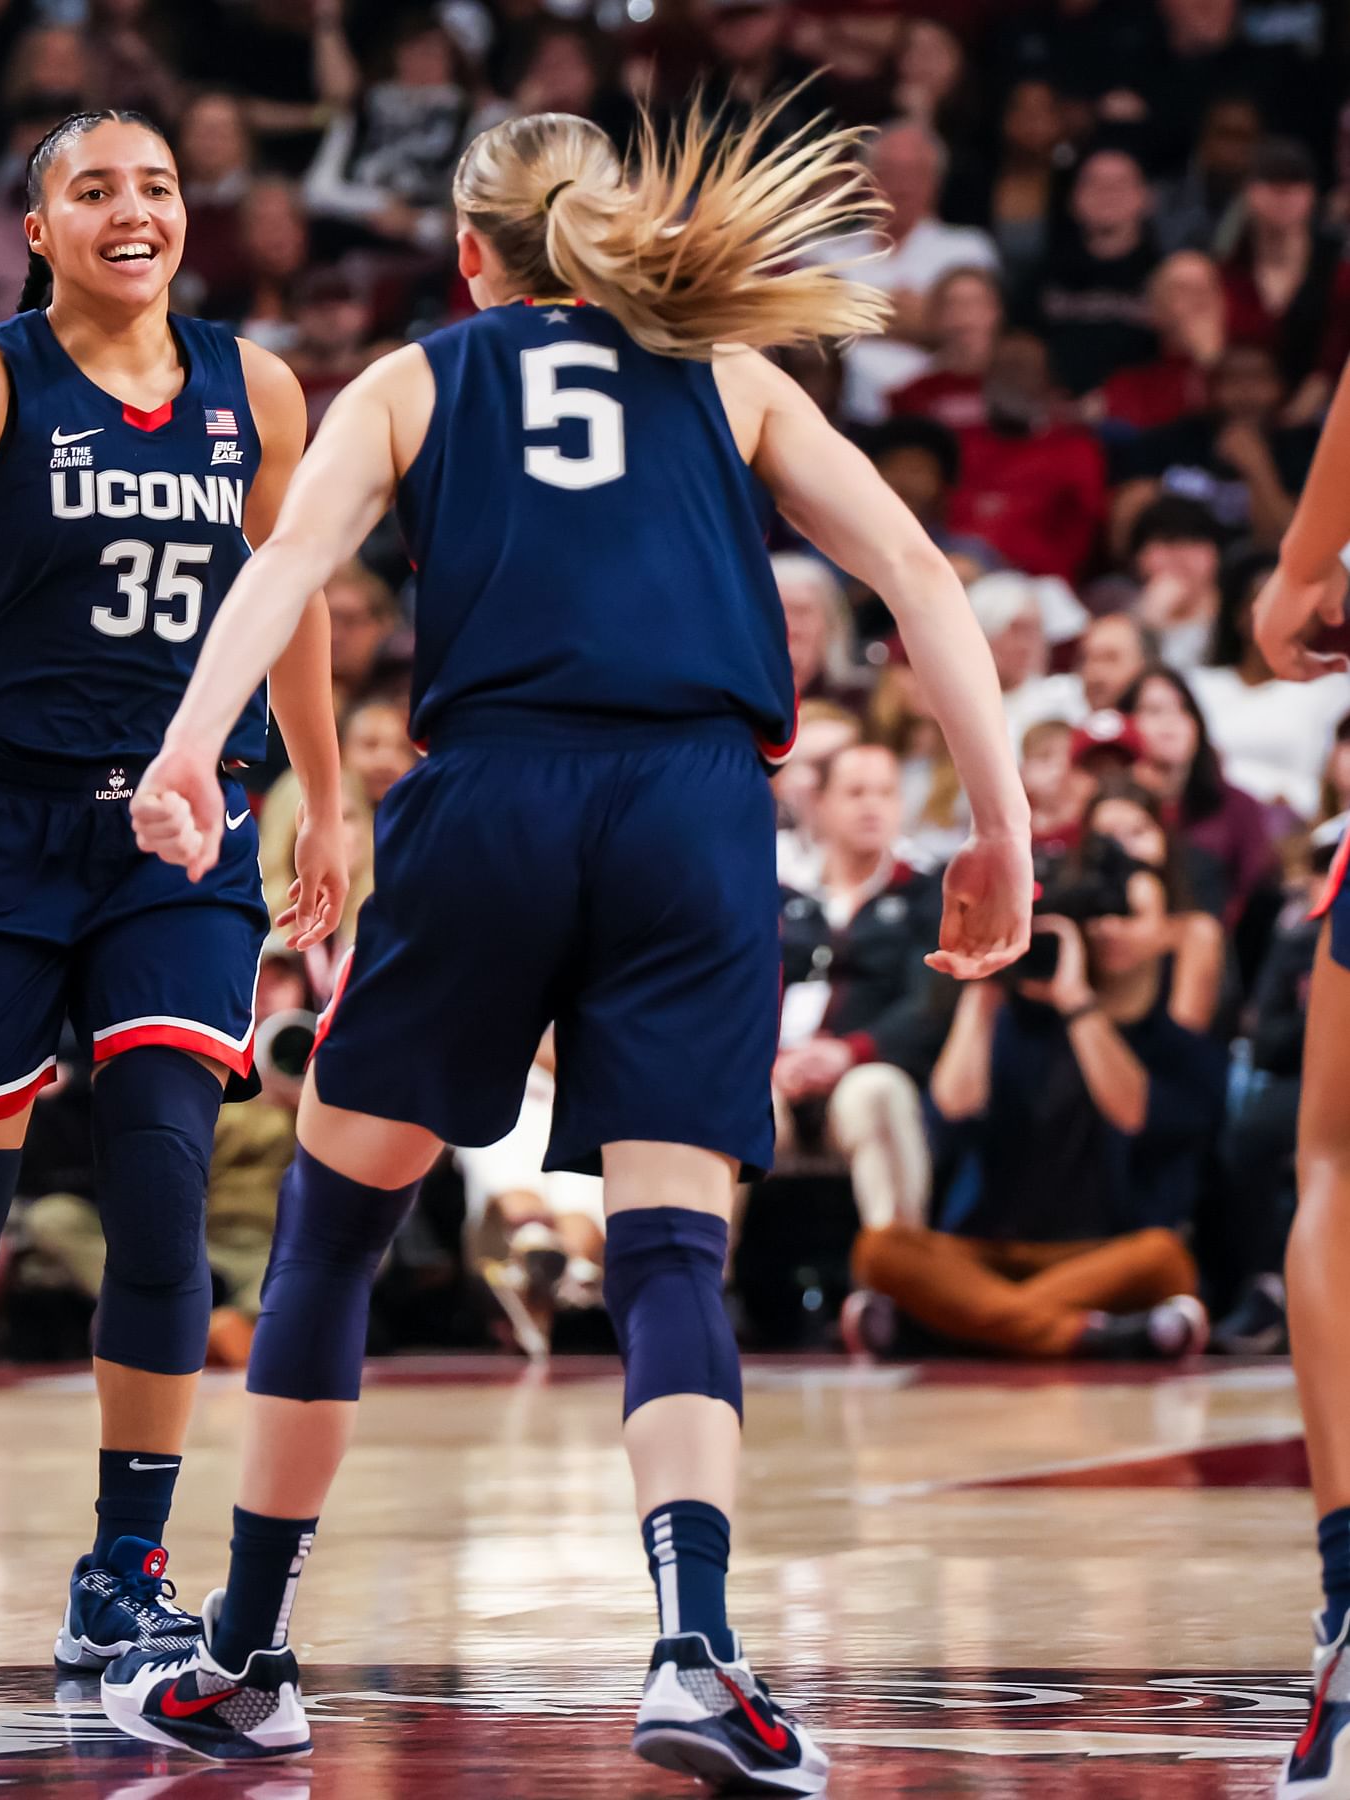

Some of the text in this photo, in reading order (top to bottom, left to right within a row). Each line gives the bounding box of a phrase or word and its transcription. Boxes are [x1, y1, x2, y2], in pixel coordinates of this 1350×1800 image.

[519, 340, 627, 491] 5
[53, 446, 91, 458] BE THE
[213, 441, 237, 452] BIG
[50, 455, 93, 469] CHANGE
[211, 450, 244, 461] EAST
[50, 468, 244, 529] UCONN
[90, 538, 214, 643] 35
[95, 788, 134, 800] UCONN
